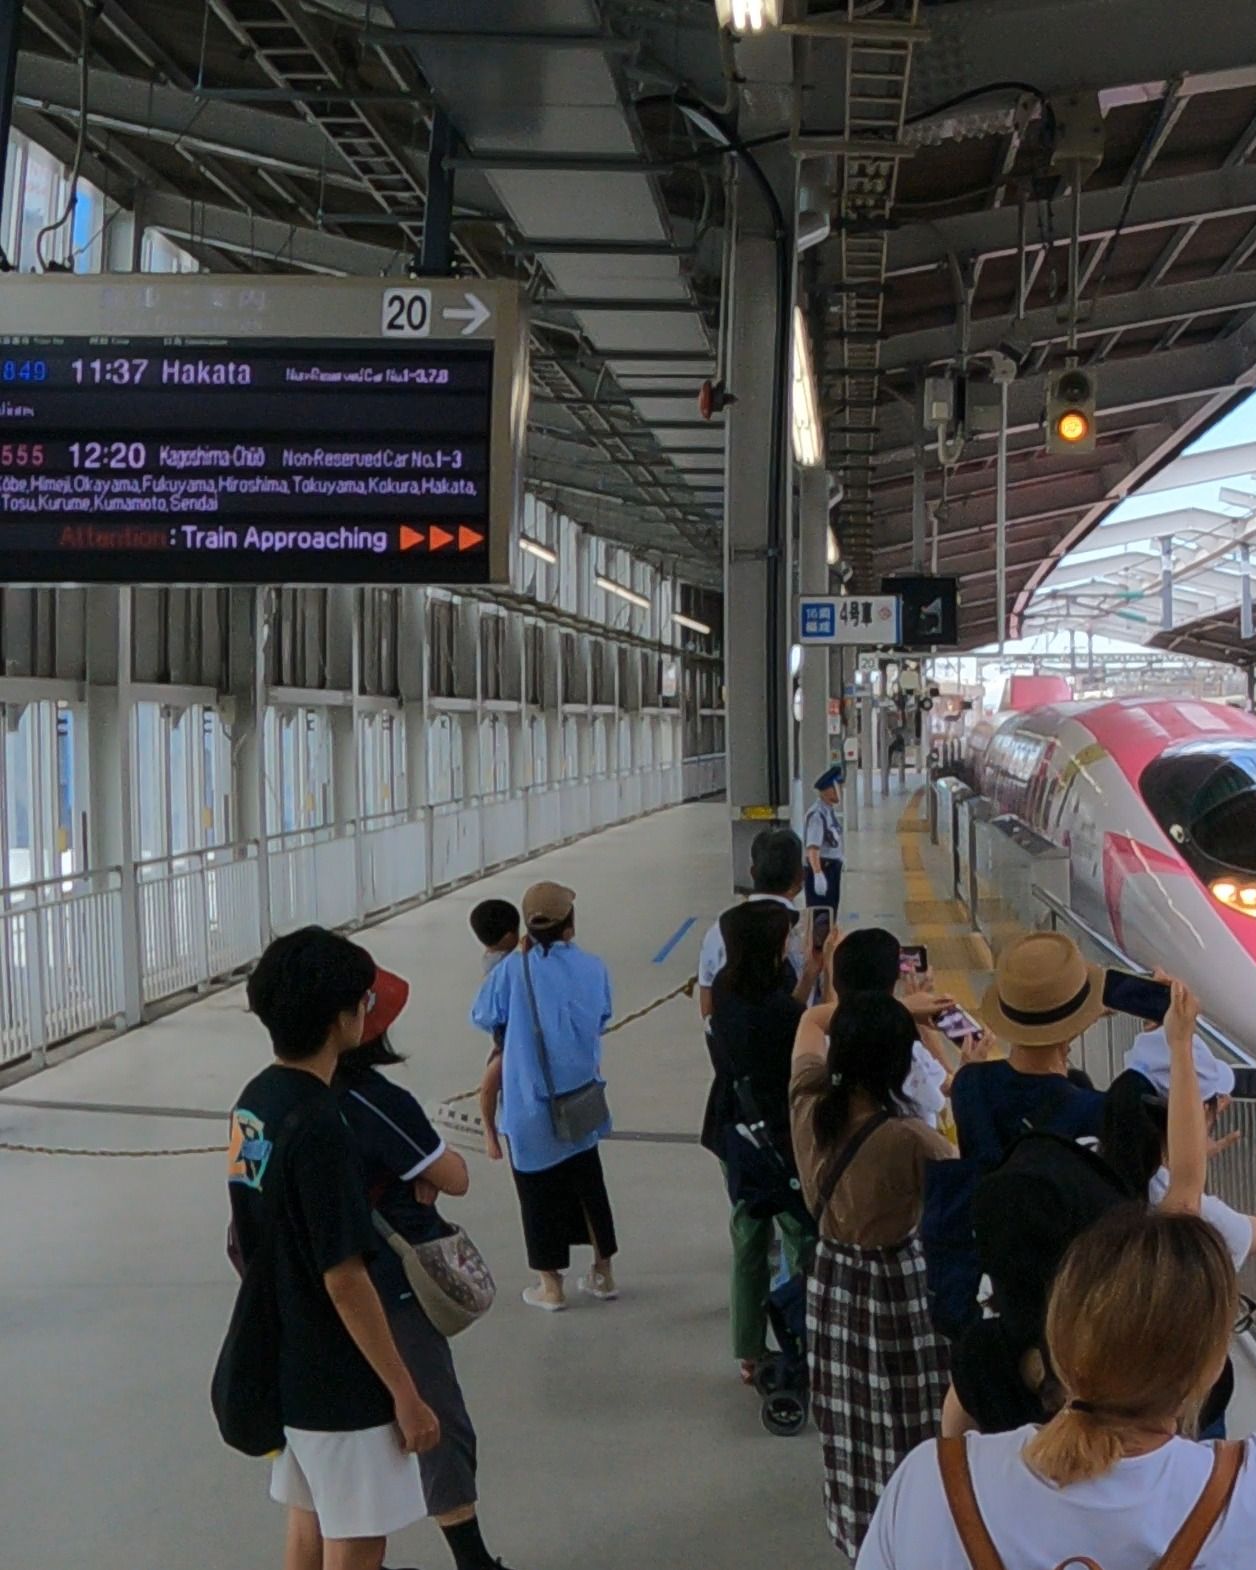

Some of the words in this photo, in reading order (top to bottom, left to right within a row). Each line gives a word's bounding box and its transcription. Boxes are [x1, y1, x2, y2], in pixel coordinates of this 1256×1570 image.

[387, 294, 427, 331] 20
[72, 358, 149, 384] 11:37
[162, 359, 251, 385] Hakata
[69, 442, 146, 469] 12:20
[181, 525, 238, 549] Train
[243, 525, 388, 552] Approaching
